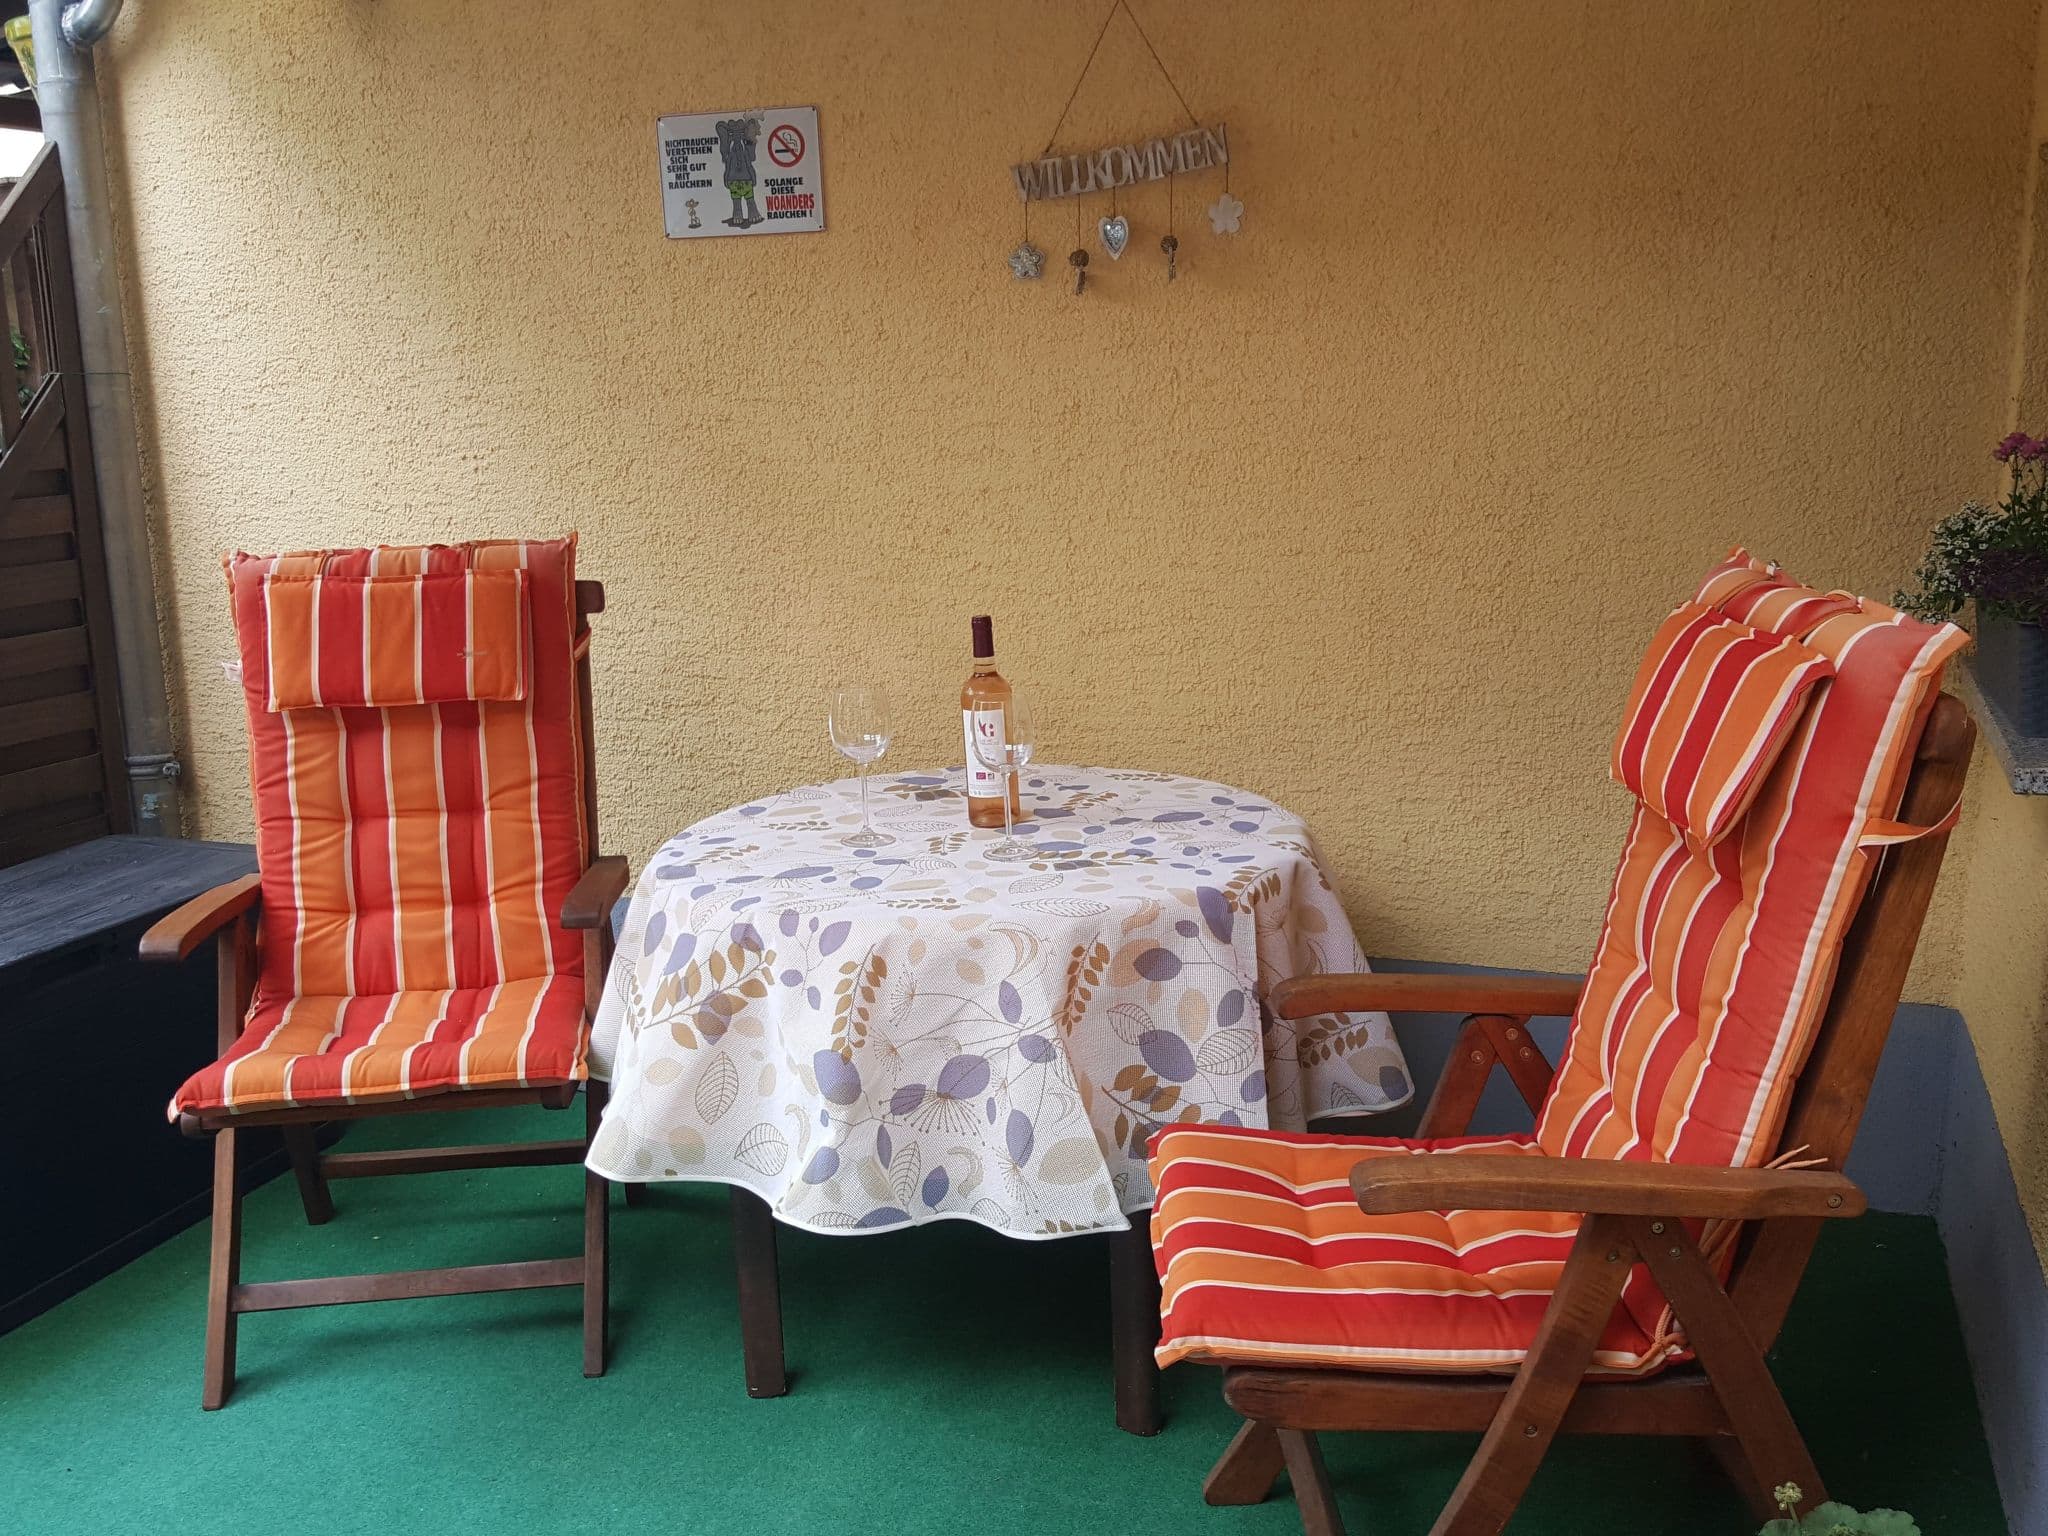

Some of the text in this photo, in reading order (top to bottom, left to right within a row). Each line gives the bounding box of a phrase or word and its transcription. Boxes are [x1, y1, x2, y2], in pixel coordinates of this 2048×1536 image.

[665, 136, 719, 149] NICHTRAUCHER
[666, 146, 712, 157] VERSTEHEN
[670, 156, 689, 165] SICH
[1012, 122, 1229, 203] WILLKOMMEN
[667, 163, 707, 174] SEHR GUT
[675, 173, 691, 181] MIT
[764, 177, 803, 188] SOLANGE
[668, 179, 713, 190] RAUCHERN
[771, 186, 795, 195] DIESE
[765, 193, 815, 212] WOANDERS
